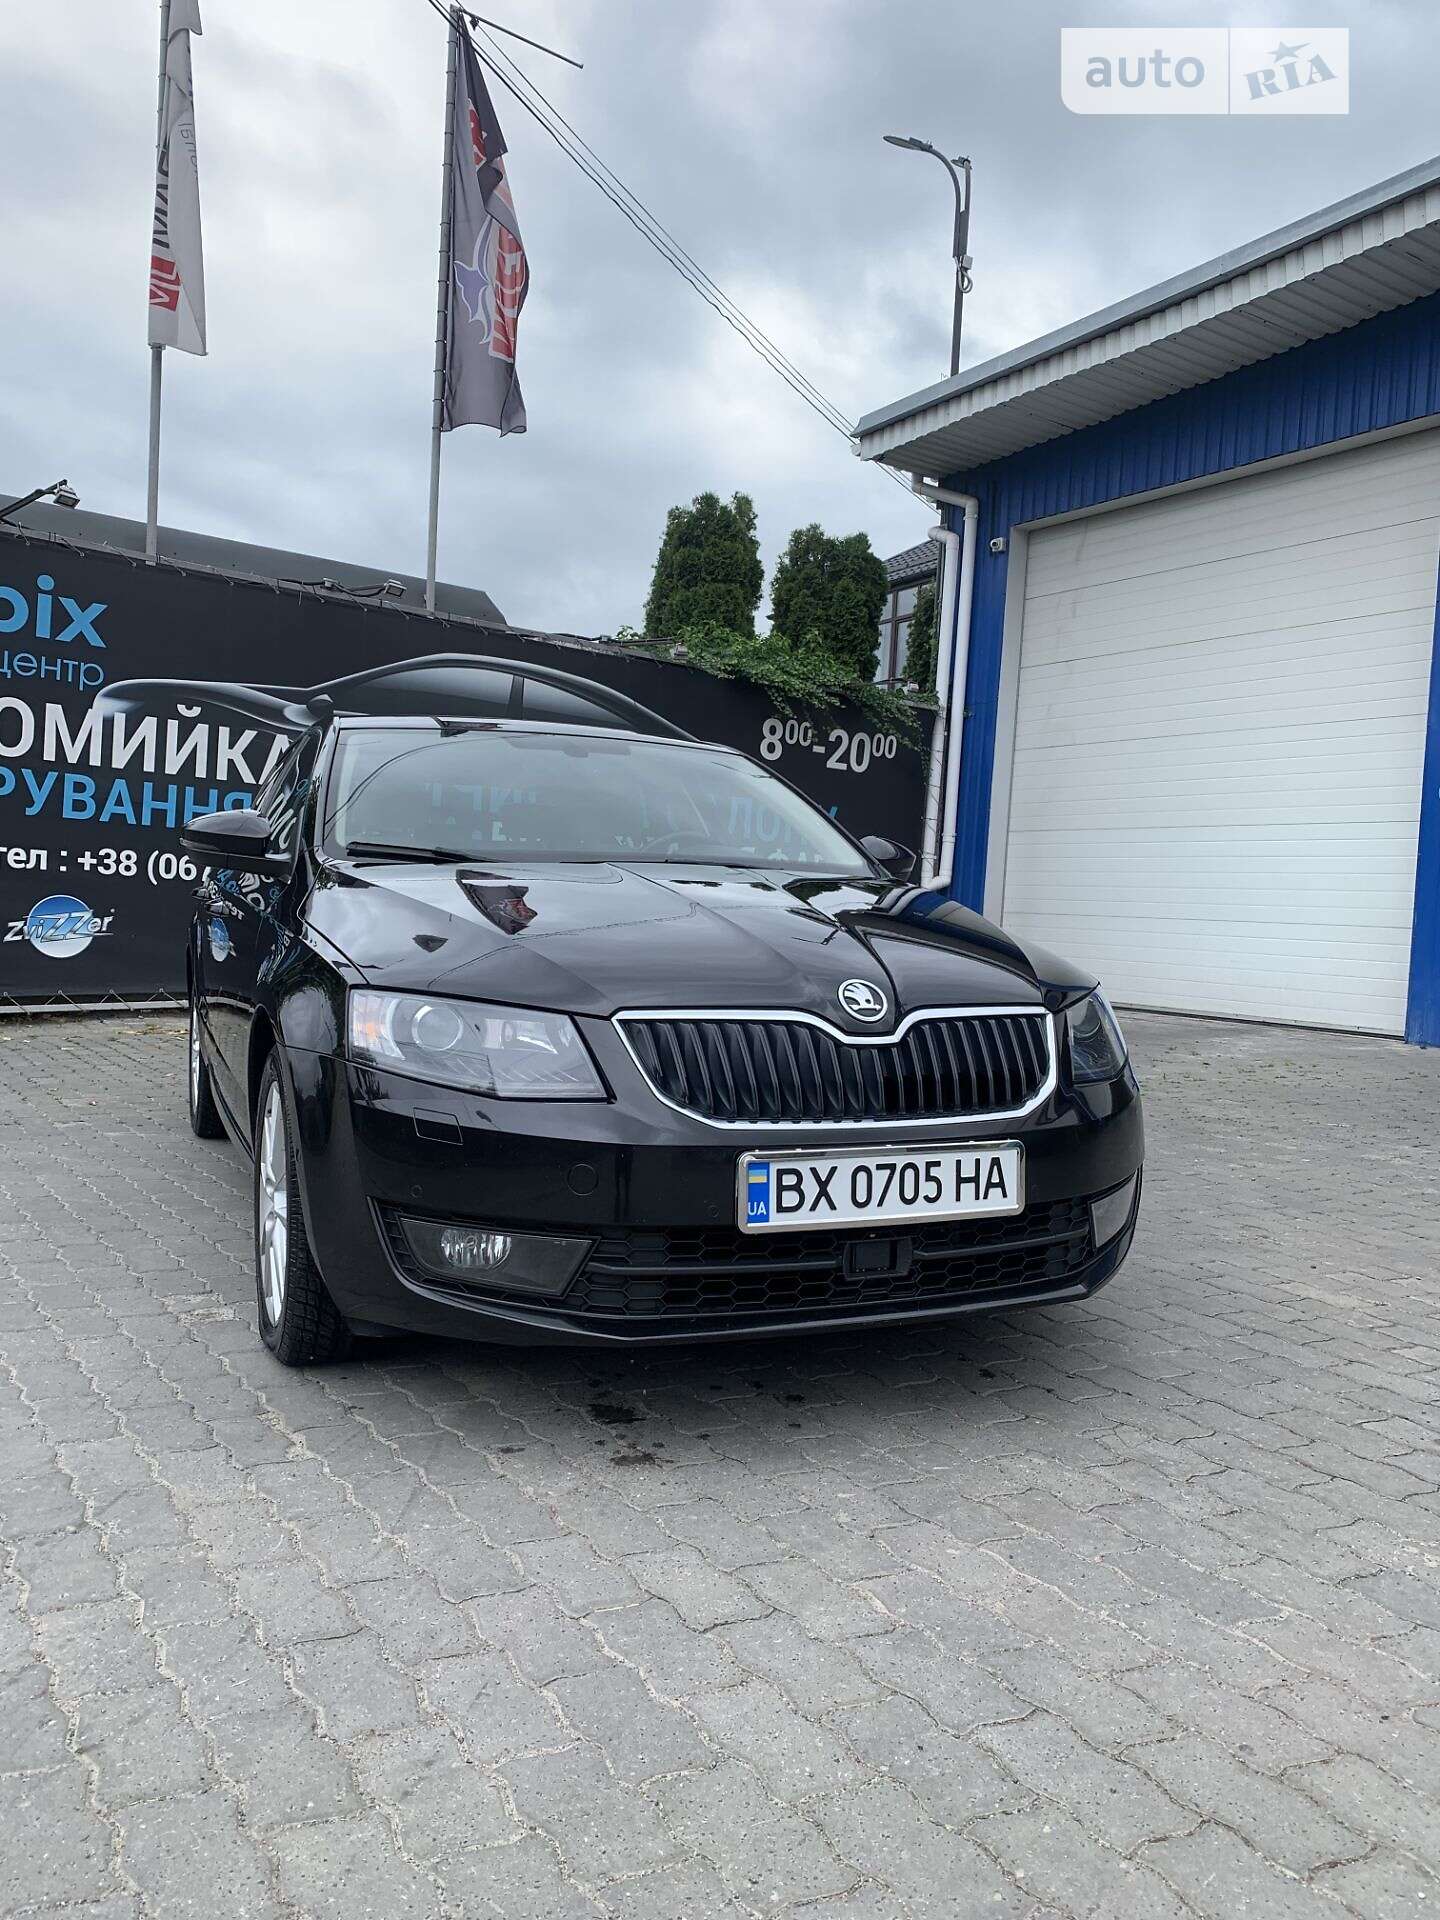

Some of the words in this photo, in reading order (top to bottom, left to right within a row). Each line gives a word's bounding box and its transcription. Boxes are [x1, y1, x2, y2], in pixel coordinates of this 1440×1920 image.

[0, 847, 48, 870] ел
[77, 847, 138, 877] +38
[776, 1166, 839, 1214] BX
[850, 1160, 943, 1209] 0705
[955, 1156, 1009, 1202] HA
[747, 1201, 768, 1216] UA
